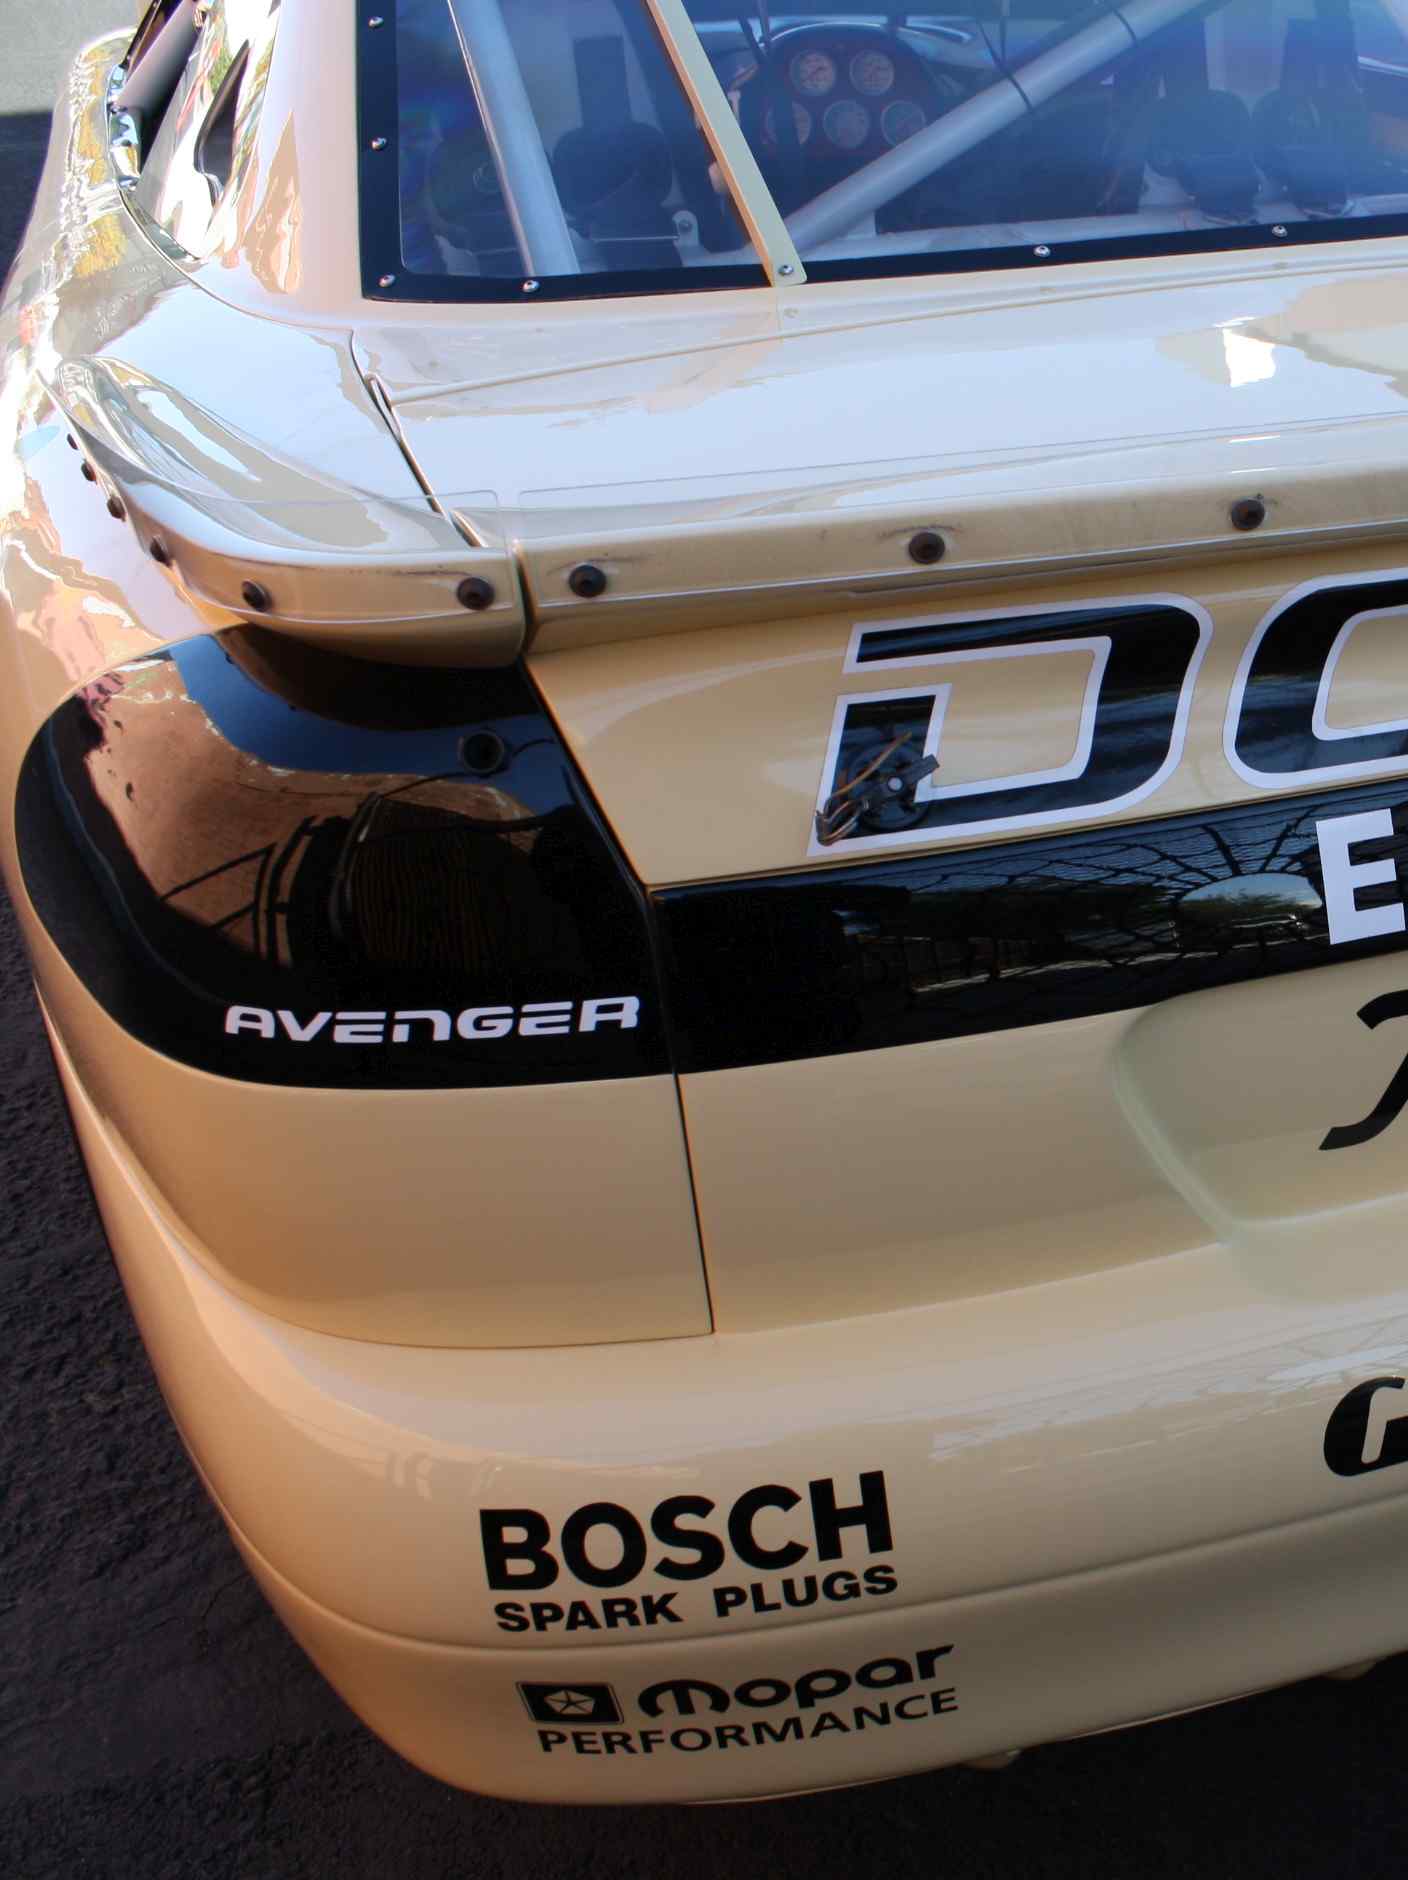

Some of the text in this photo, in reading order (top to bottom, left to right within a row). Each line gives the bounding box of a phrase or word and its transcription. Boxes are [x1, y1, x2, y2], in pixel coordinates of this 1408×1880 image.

[224, 995, 640, 1044] AVENGER
[480, 1470, 893, 1591] BOSCH
[494, 1565, 898, 1632] SPARK PLUGS
[537, 1687, 959, 1755] PERFORMANCE
